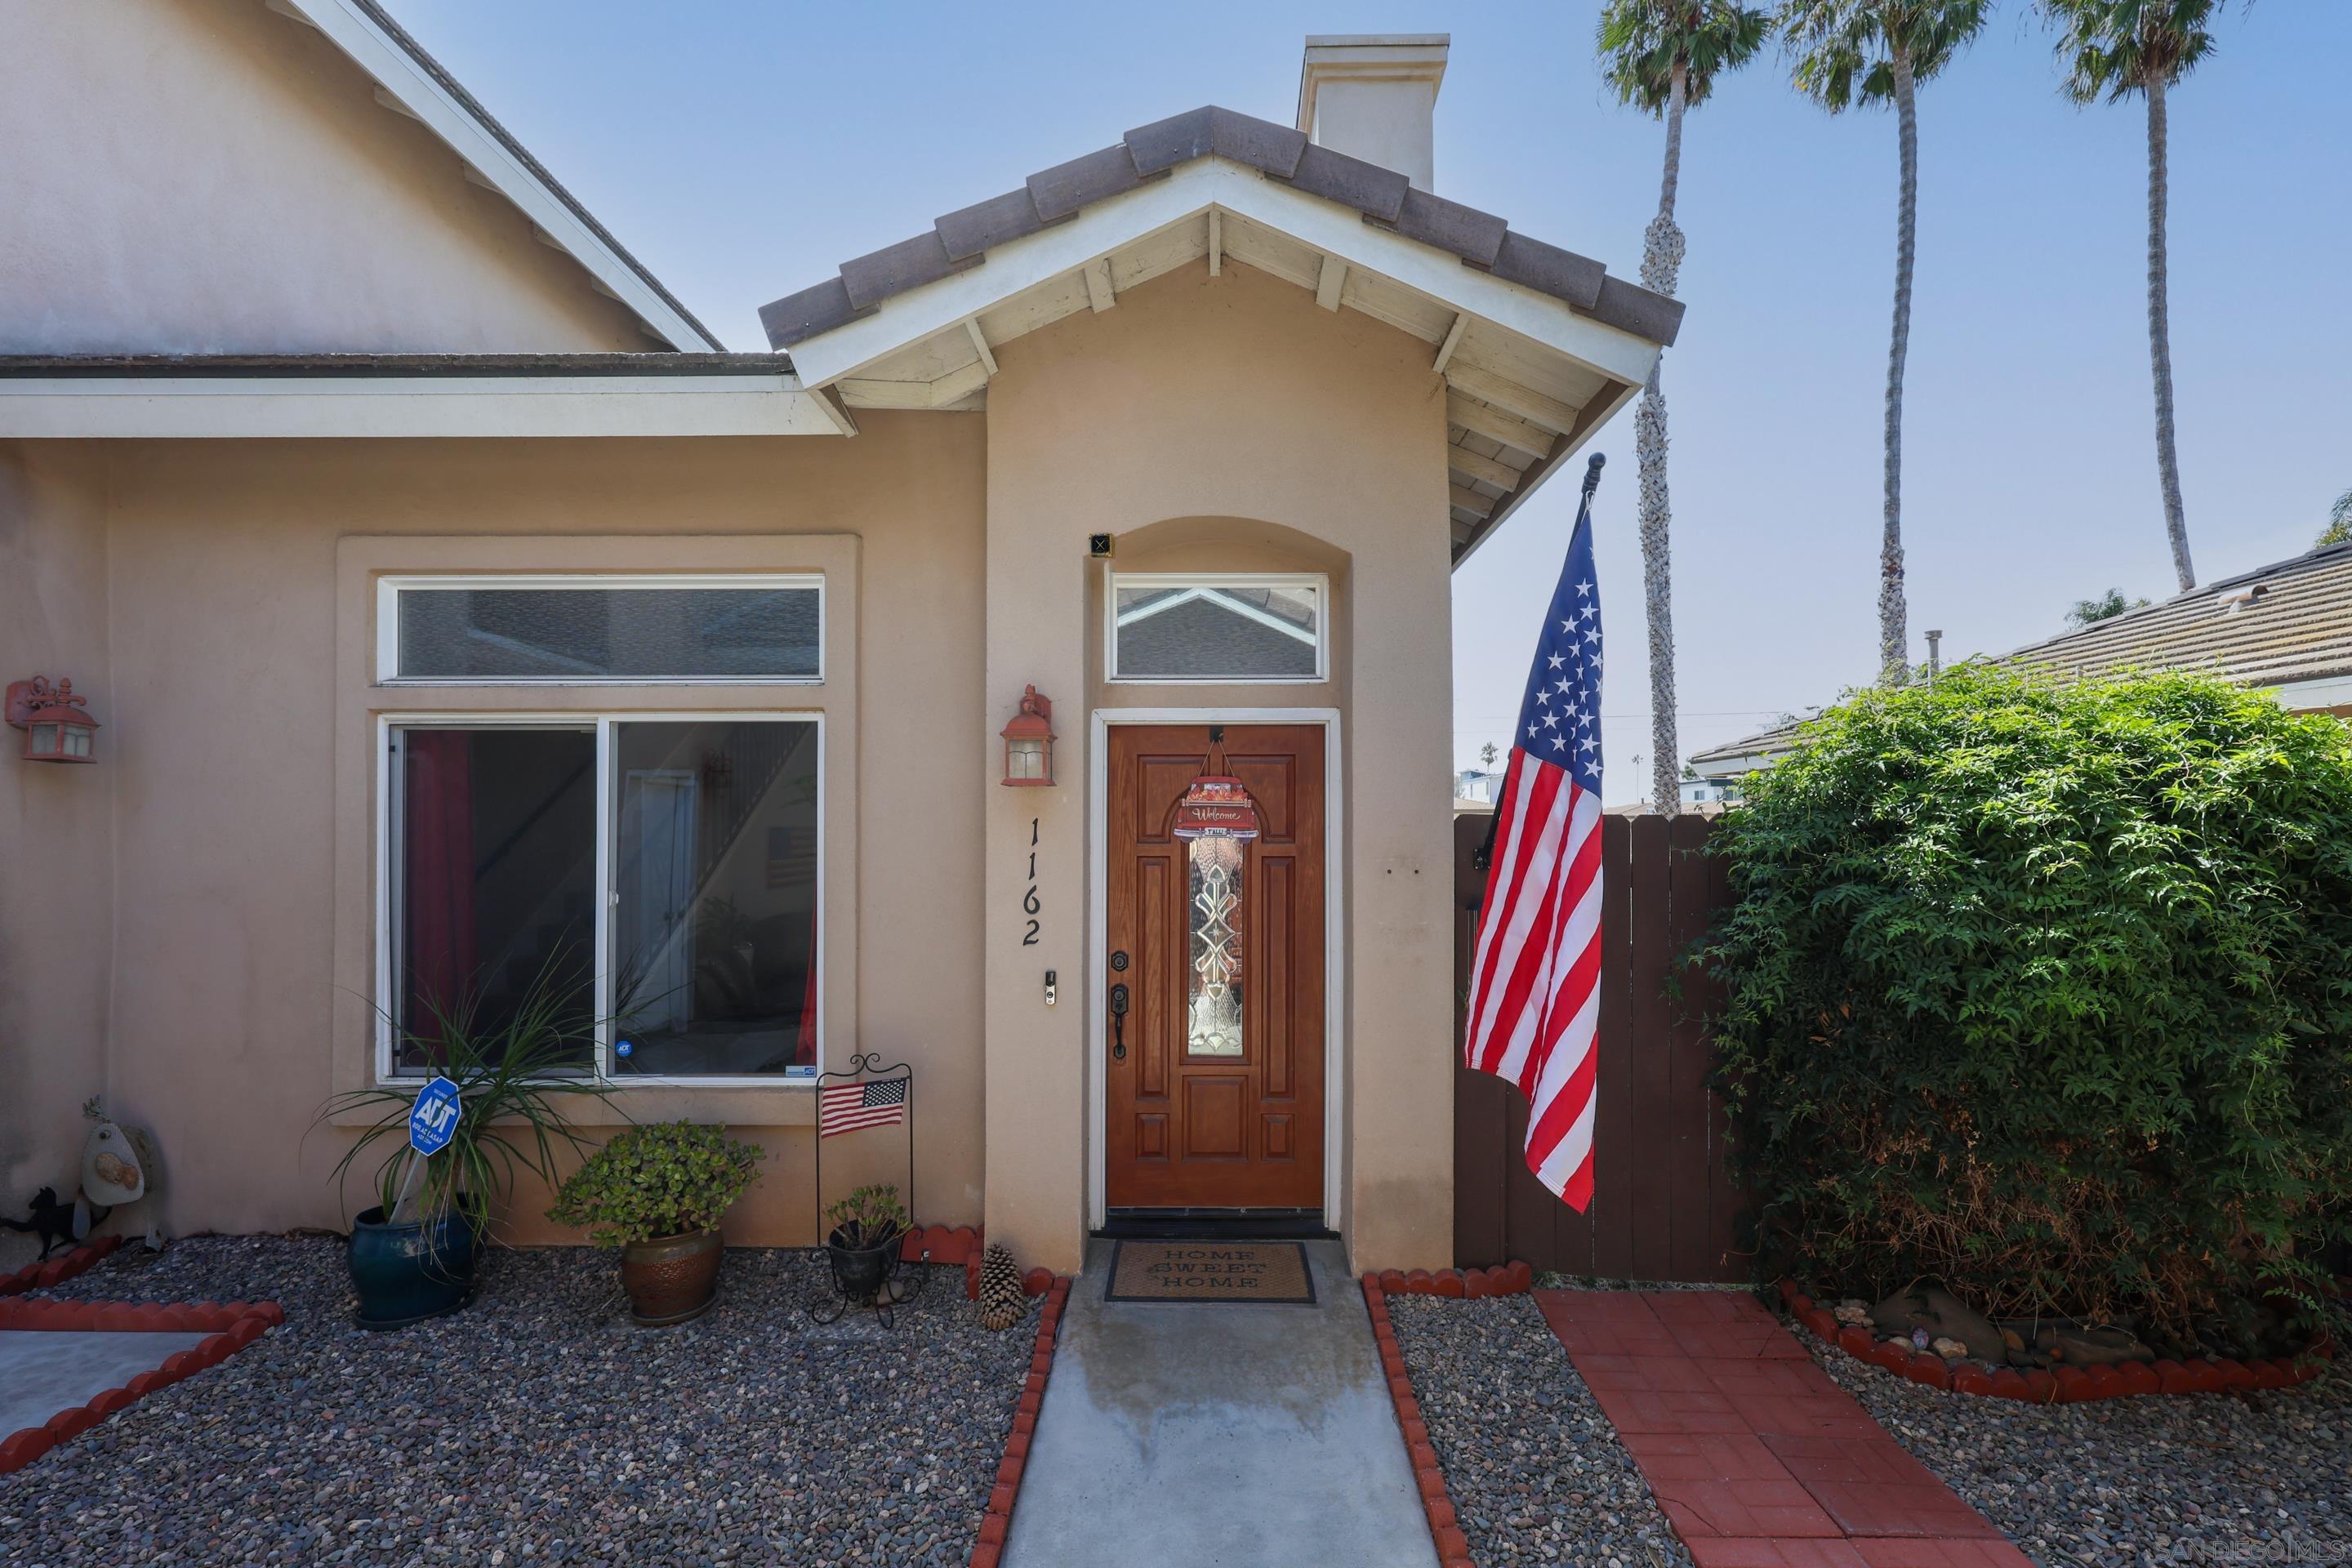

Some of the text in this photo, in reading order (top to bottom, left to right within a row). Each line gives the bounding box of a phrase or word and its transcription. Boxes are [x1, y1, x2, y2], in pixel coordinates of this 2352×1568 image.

[1192, 808, 1241, 821] Welcome
[1023, 817, 1040, 946] 1162
[415, 1096, 457, 1134] ADT
[1165, 1250, 1255, 1260] HOME
[1153, 1263, 1266, 1274] SWEET
[1162, 1277, 1258, 1288] HOME
